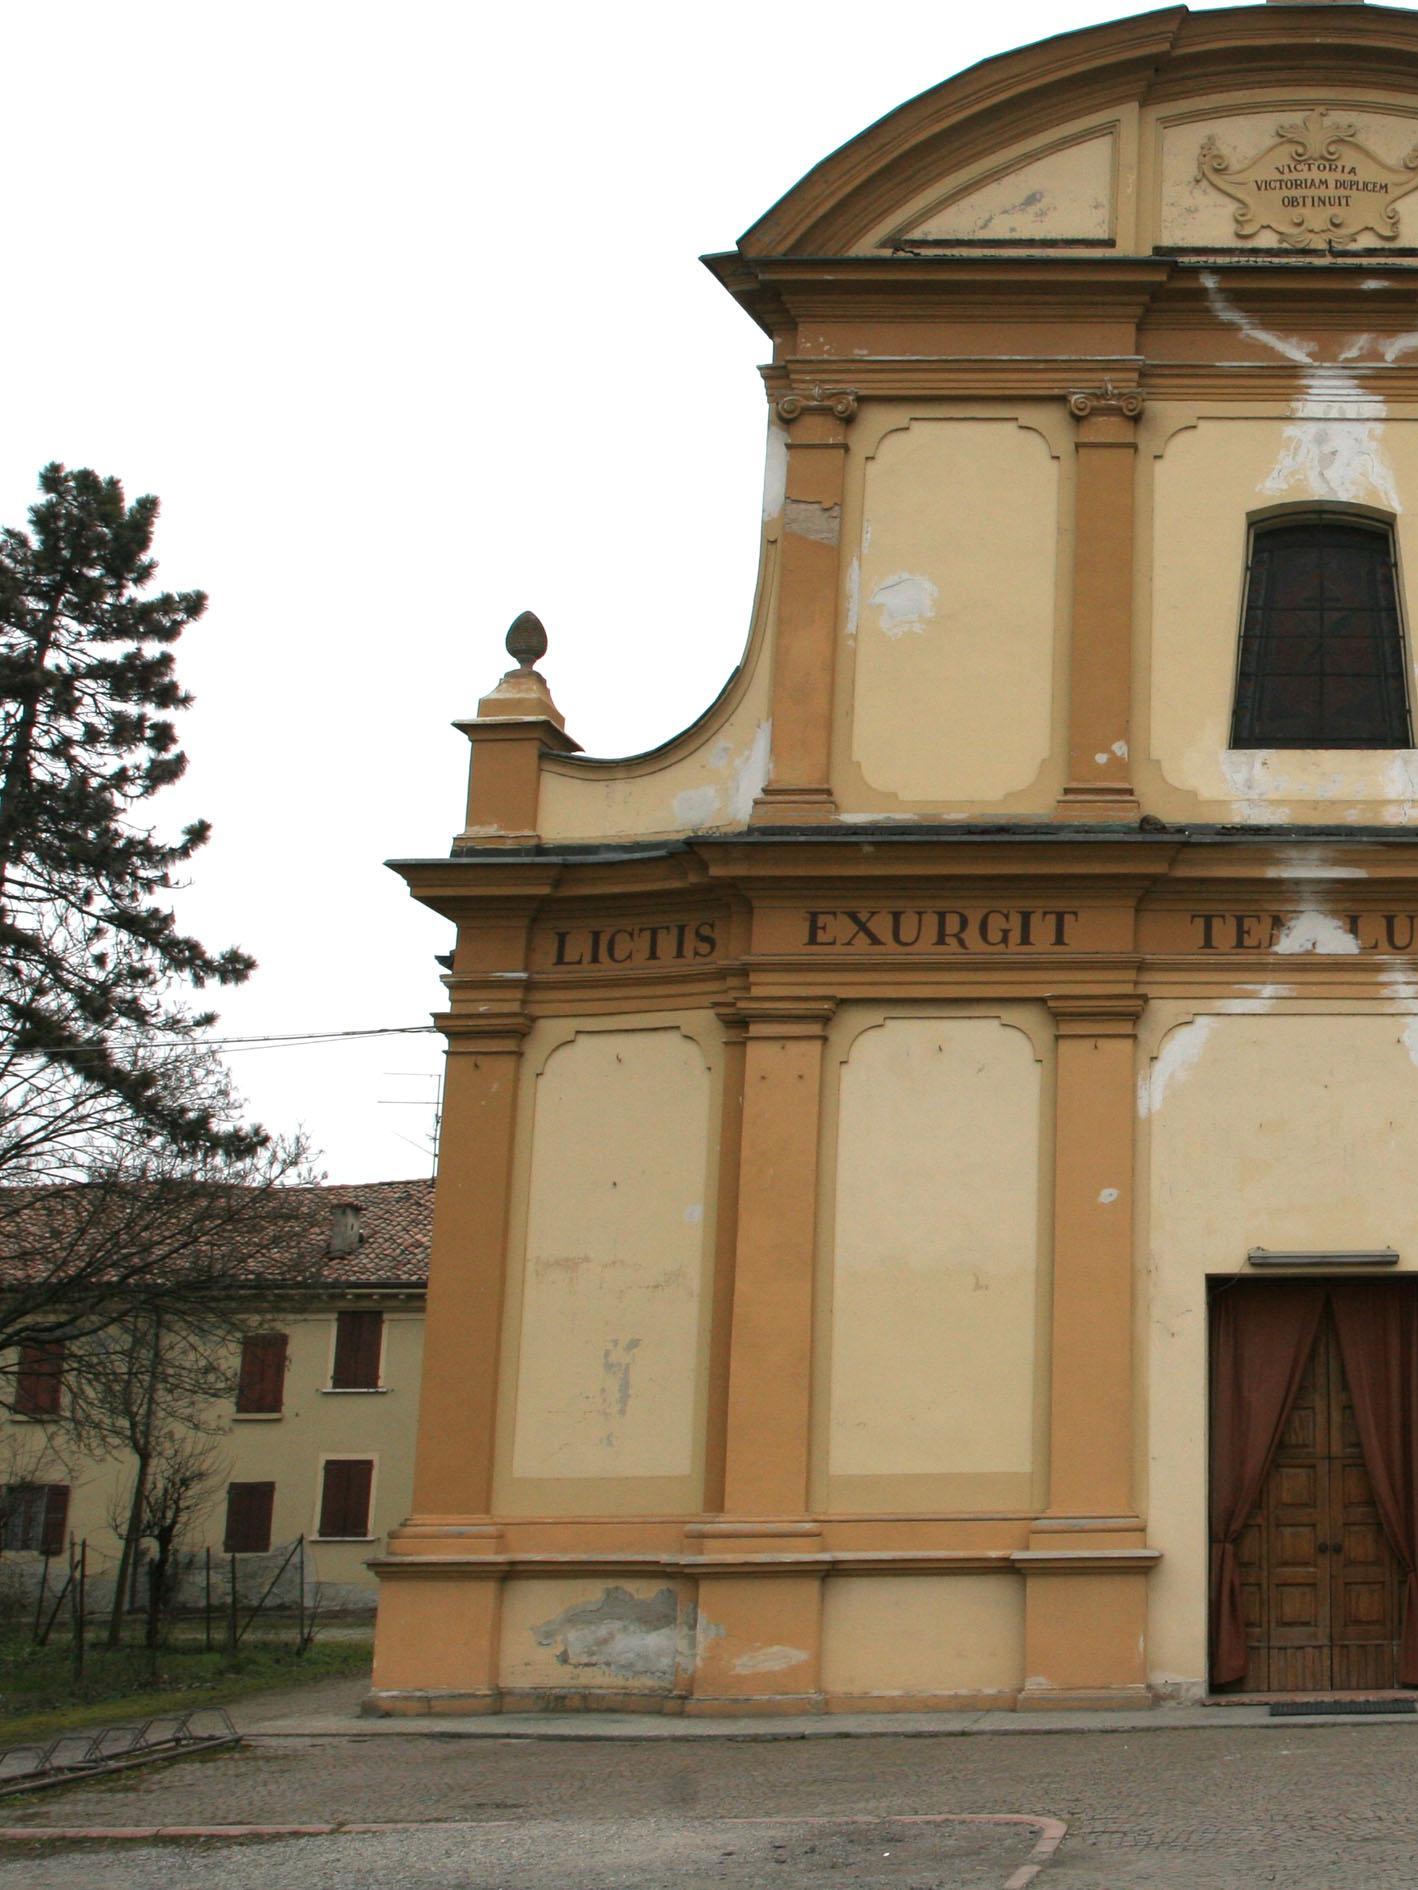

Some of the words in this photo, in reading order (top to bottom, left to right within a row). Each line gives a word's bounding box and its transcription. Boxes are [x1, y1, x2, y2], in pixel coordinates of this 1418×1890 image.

[1274, 162, 1357, 176] VICTORIA
[1255, 178, 1329, 192] VICTORIAM
[1335, 179, 1389, 194] DUPLICEM
[1282, 195, 1352, 208] OBTINUIT
[552, 920, 718, 967] LICTIS
[803, 909, 1080, 950] EXURGIT
